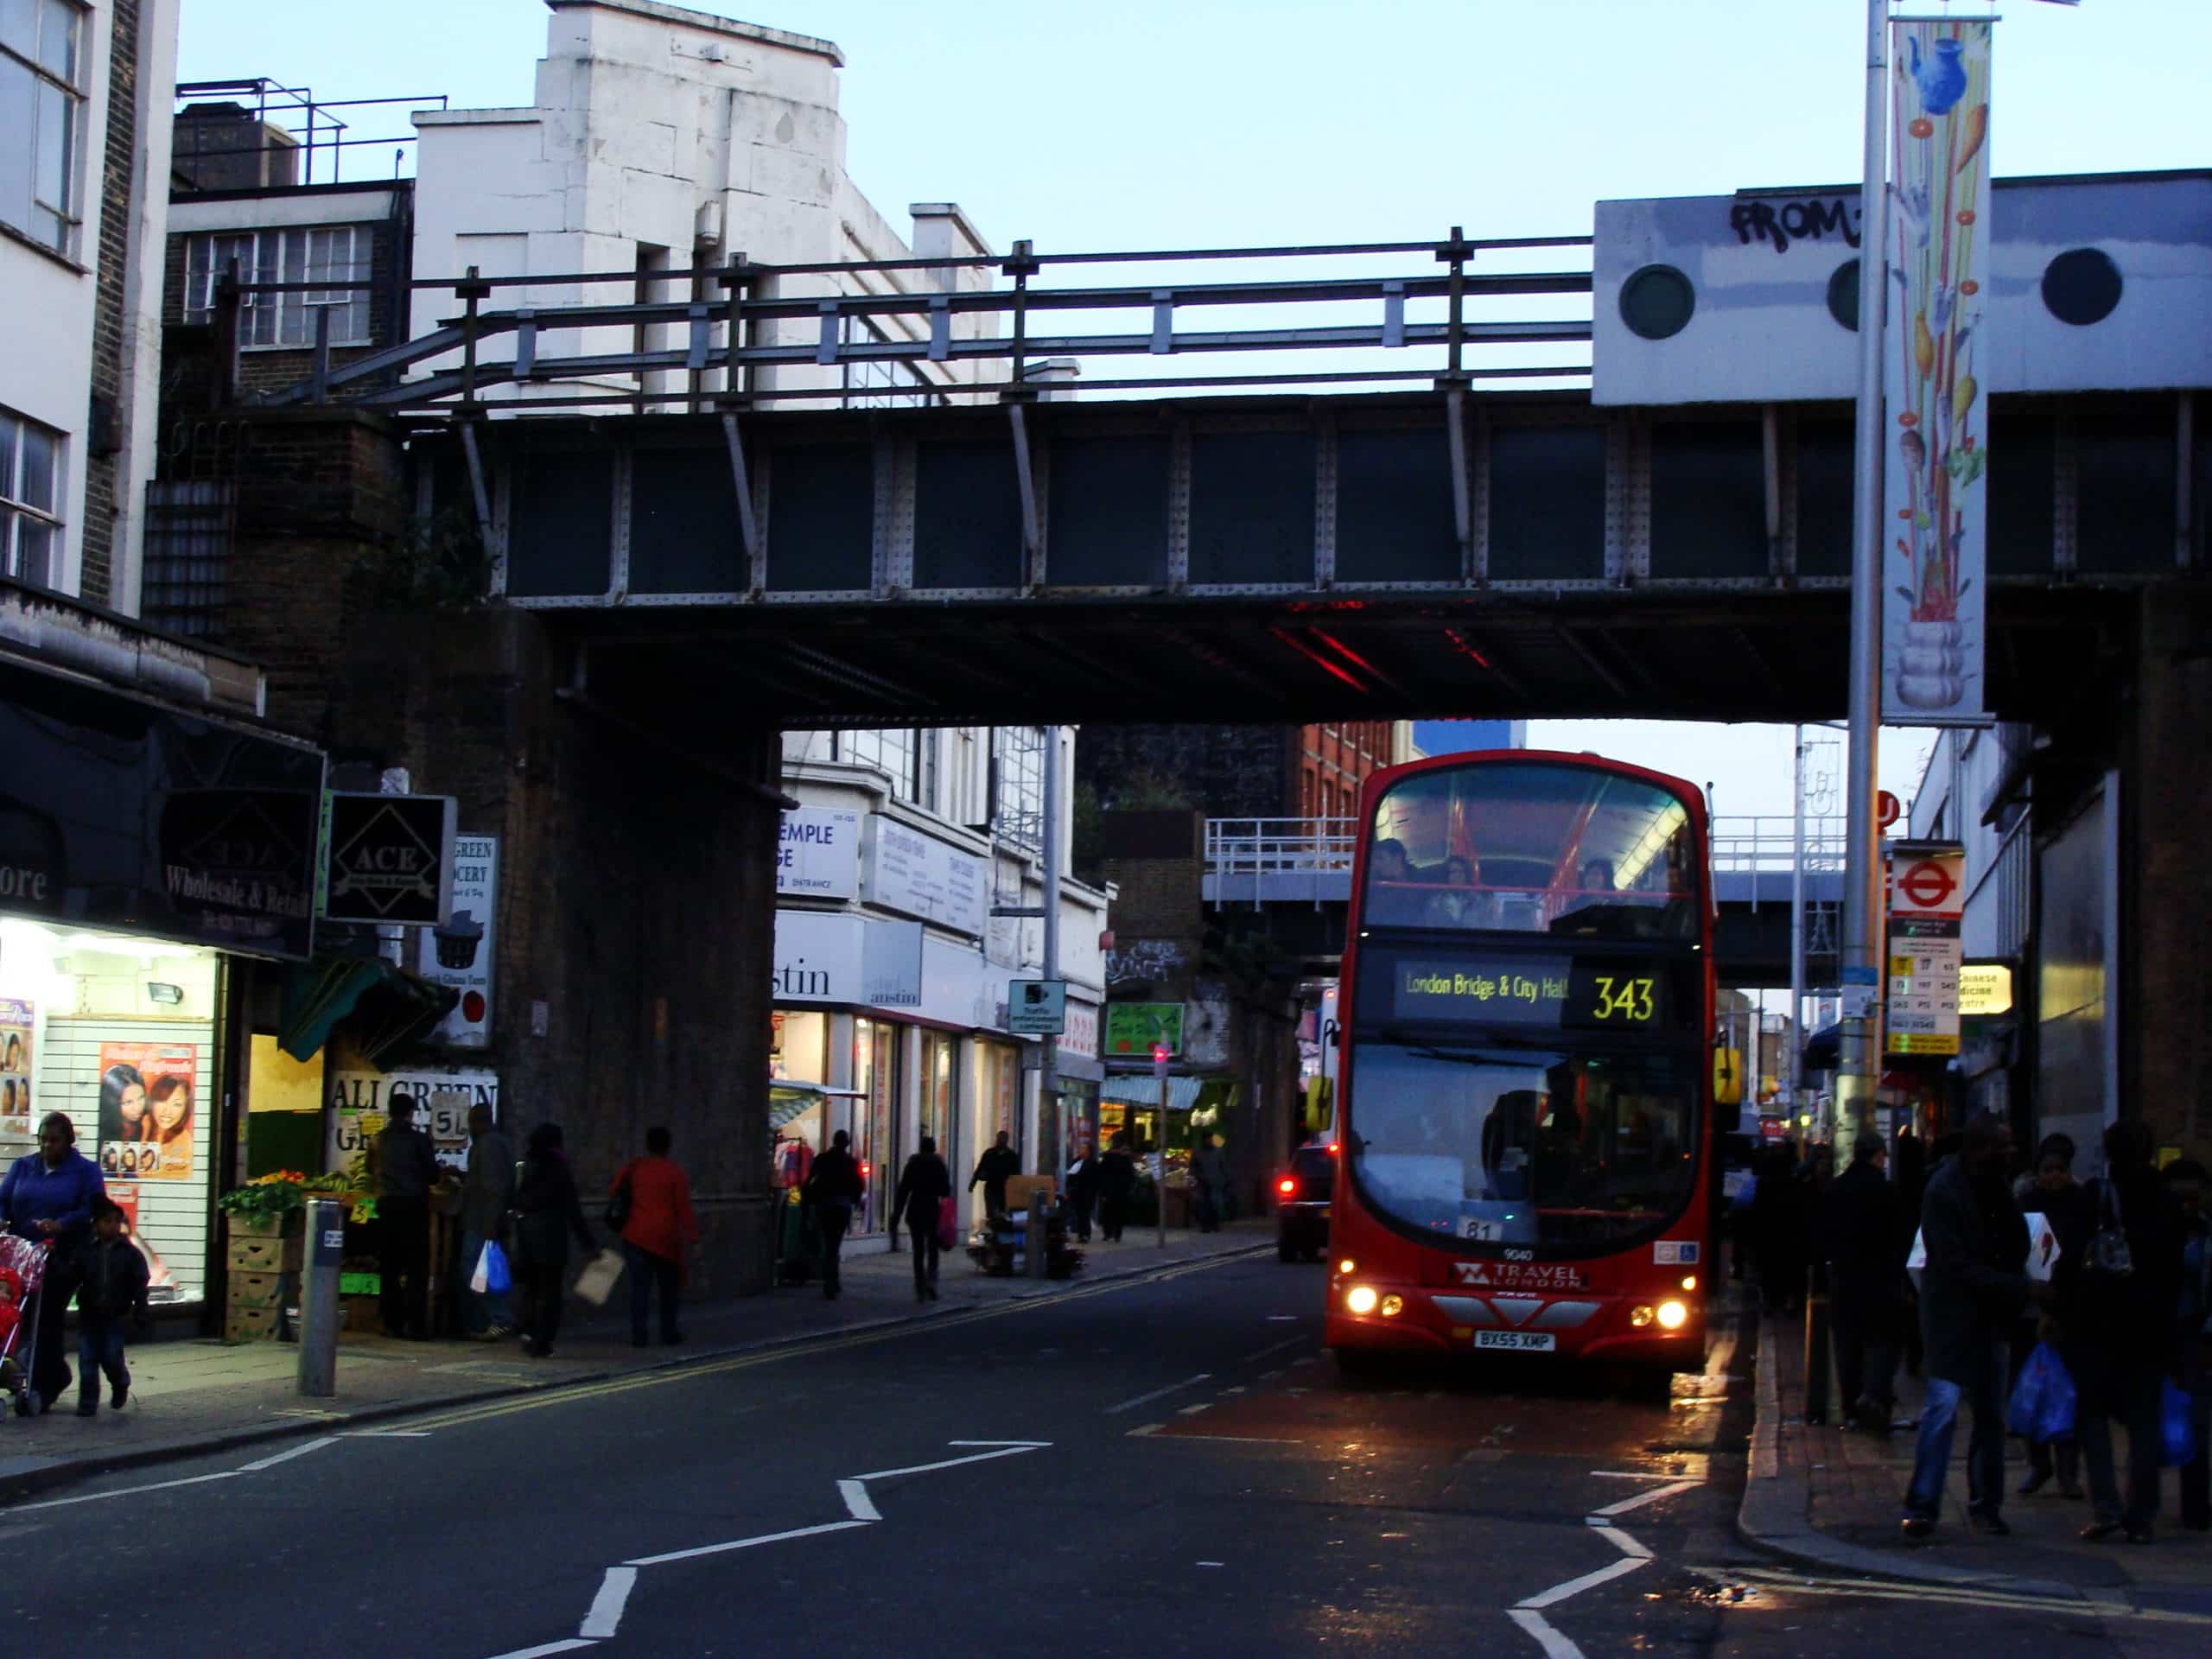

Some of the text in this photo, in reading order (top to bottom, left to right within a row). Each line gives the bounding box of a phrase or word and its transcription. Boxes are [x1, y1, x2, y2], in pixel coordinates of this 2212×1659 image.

[353, 844, 418, 872] ACE
[166, 864, 245, 908] Wholesale
[250, 880, 263, 909] &
[1406, 970, 1570, 1003] London Bridge & City Hall
[1593, 976, 1655, 1020] 343
[332, 1079, 380, 1109] ALI
[1466, 1222, 1491, 1240] 81
[1492, 1278, 1582, 1288] LONDON
[1493, 1264, 1580, 1281] TRAVEL
